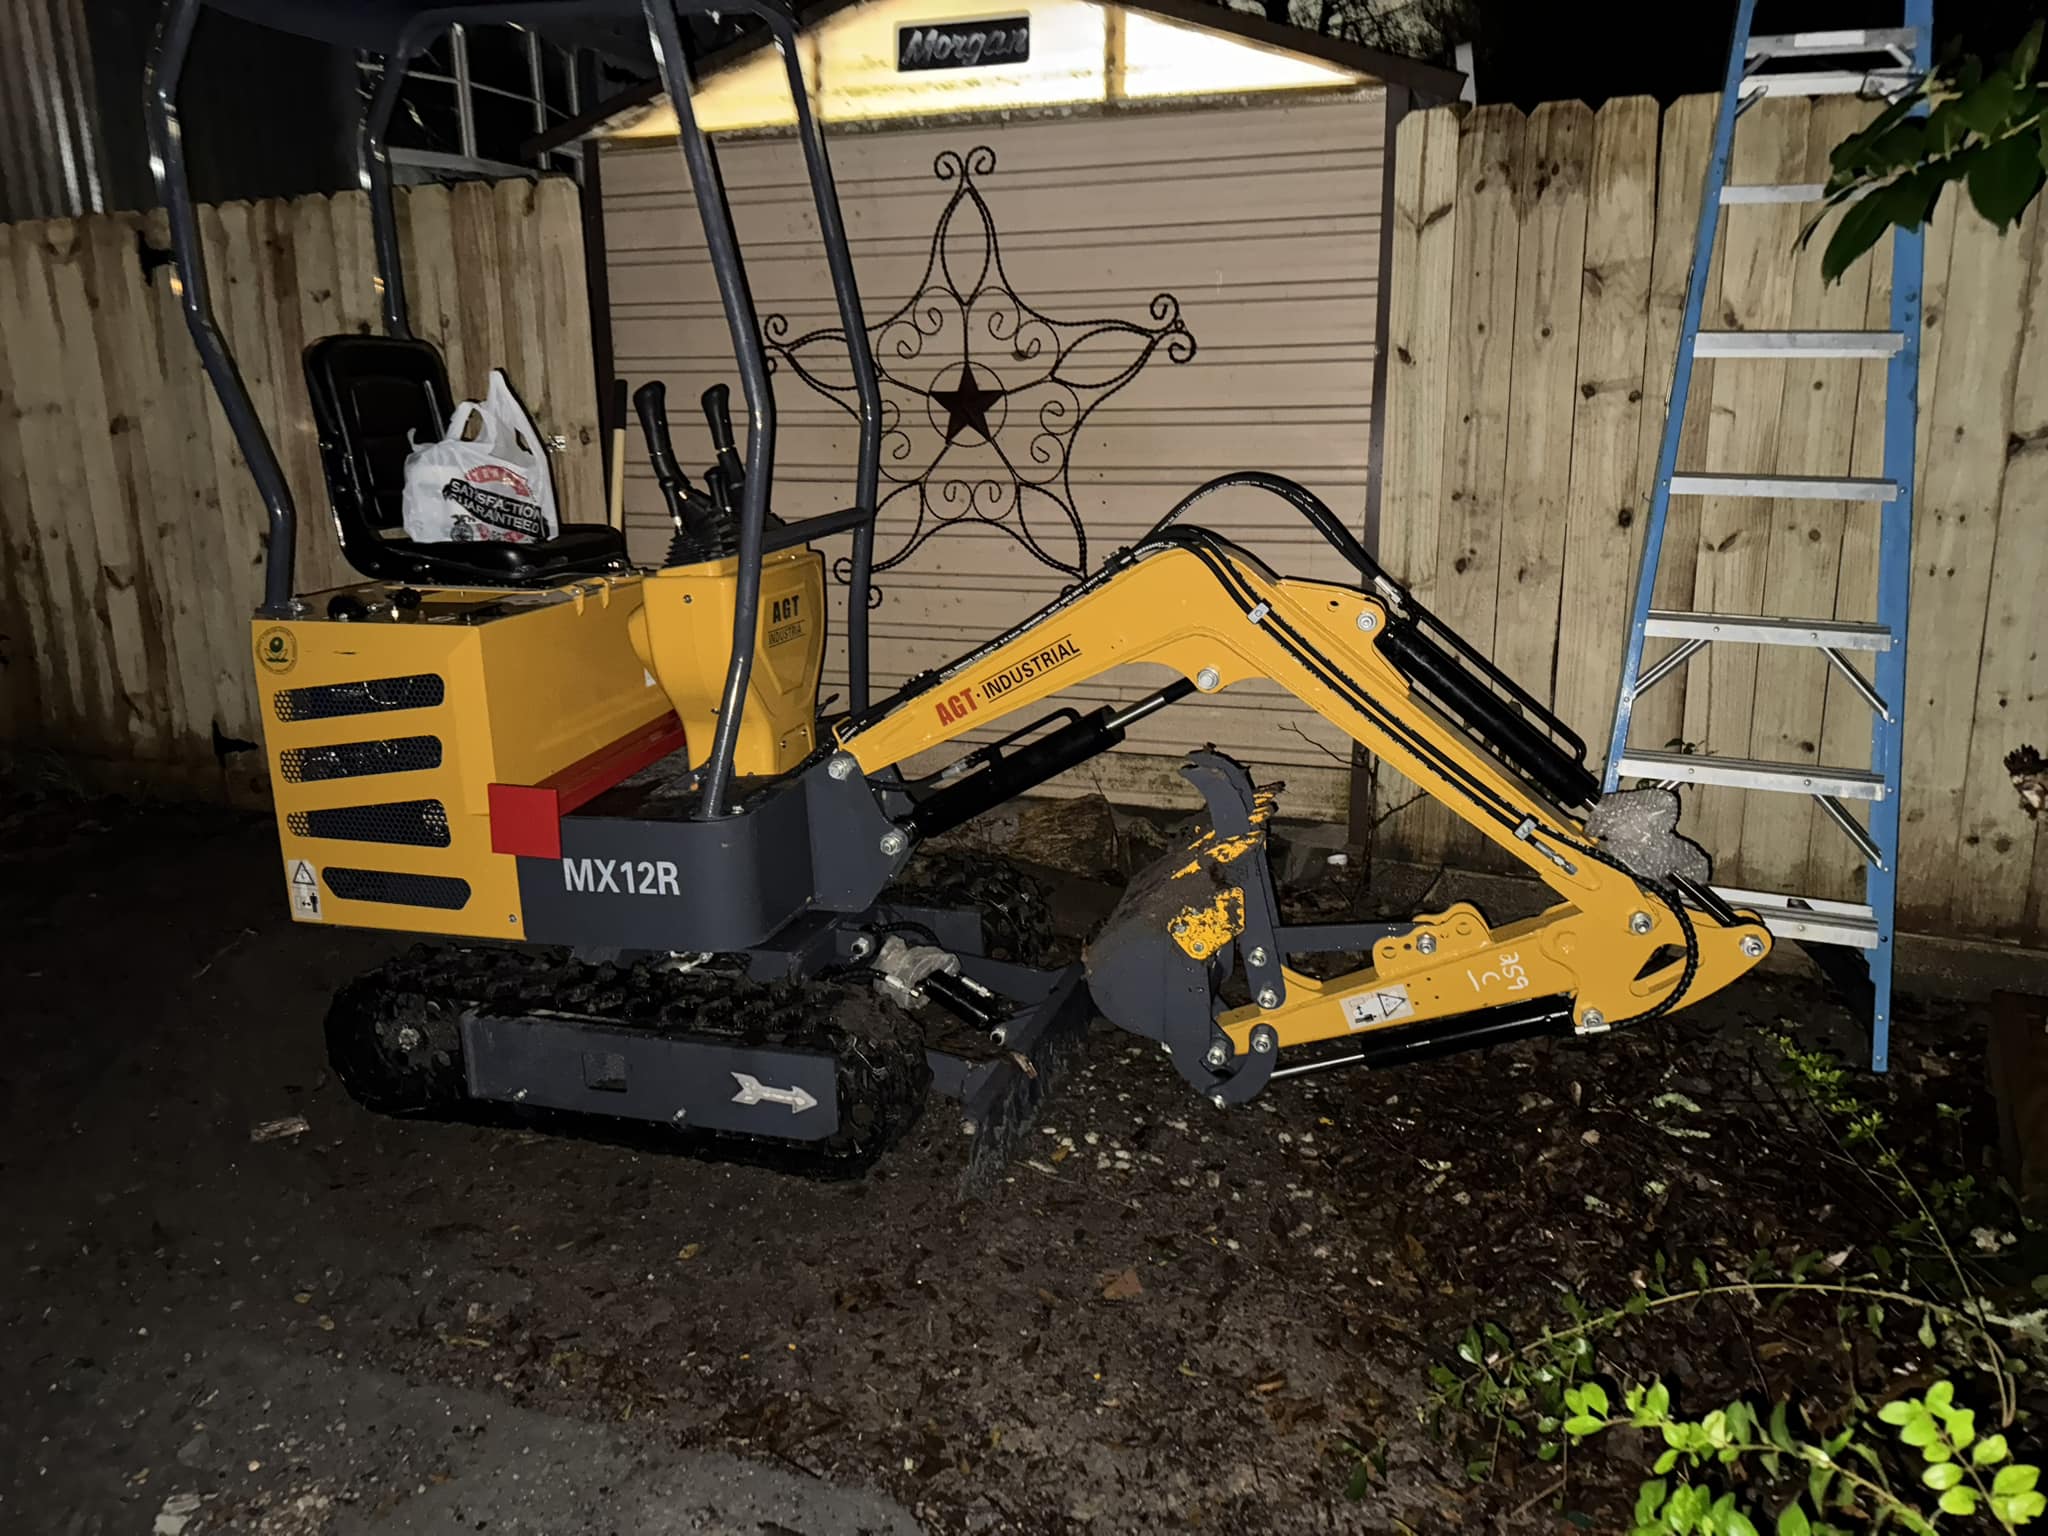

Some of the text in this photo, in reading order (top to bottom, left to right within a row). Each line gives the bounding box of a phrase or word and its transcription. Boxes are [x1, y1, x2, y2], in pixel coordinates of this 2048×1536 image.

[901, 28, 1028, 66] Morgan
[772, 594, 800, 624] AGT
[935, 687, 978, 727] AGT
[981, 638, 1081, 699] INDUSTRIAL
[562, 857, 681, 896] MX12R
